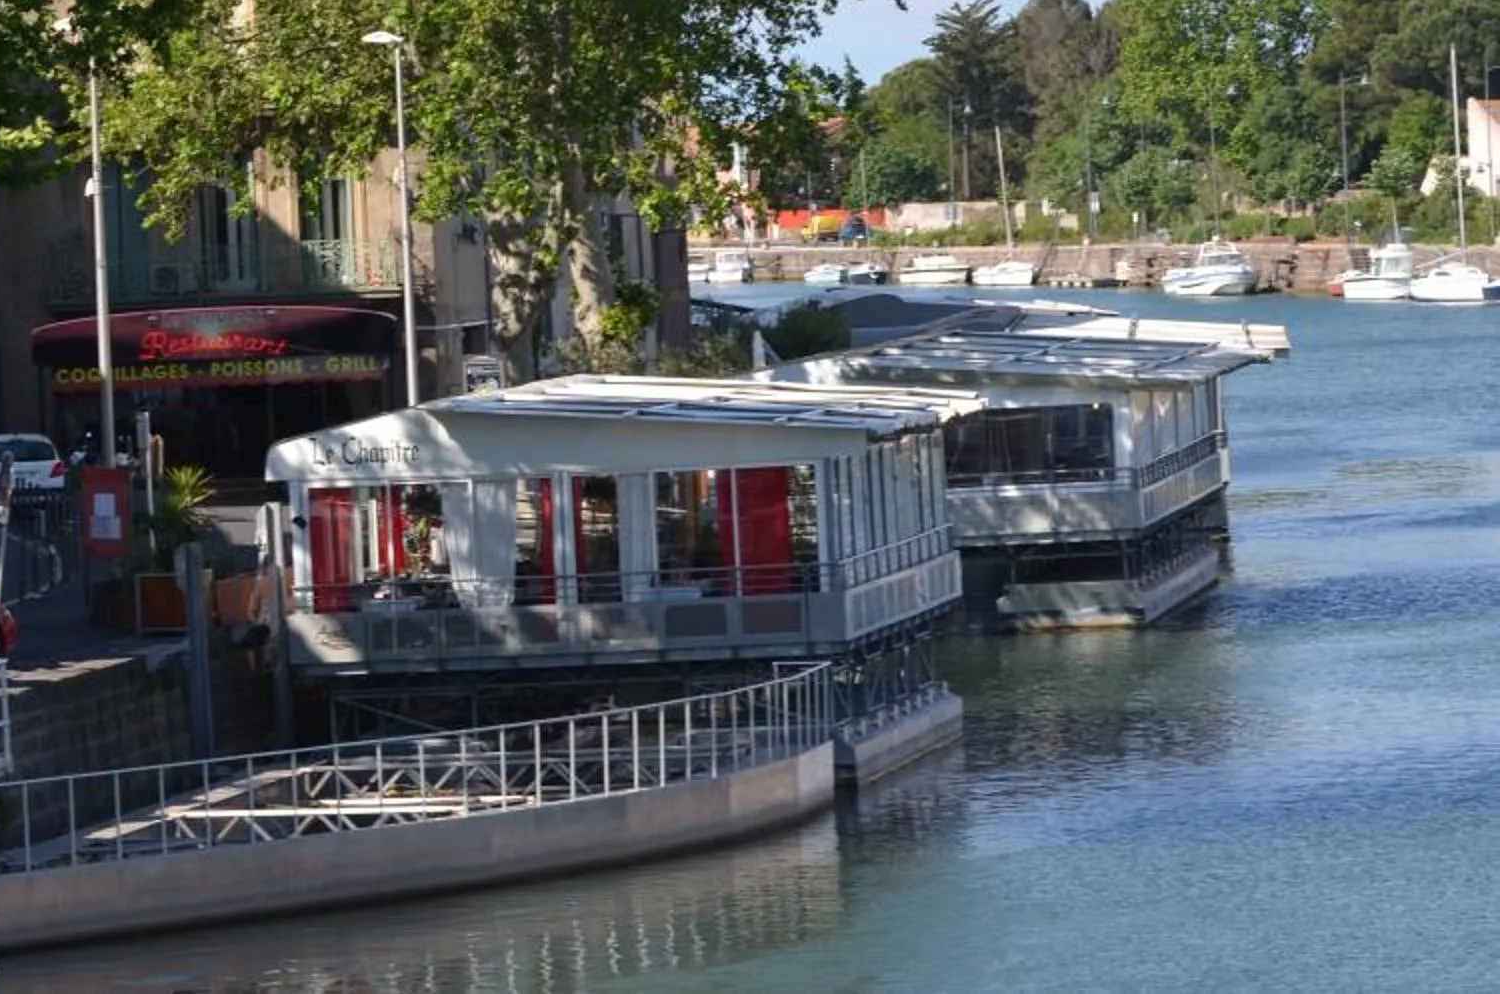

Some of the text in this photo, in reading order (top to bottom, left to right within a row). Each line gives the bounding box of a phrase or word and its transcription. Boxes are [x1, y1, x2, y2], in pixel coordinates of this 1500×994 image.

[56, 363, 190, 385] COQILLAGES
[210, 358, 304, 377] POISSONS
[324, 355, 378, 373] GRILL
[308, 435, 421, 470] Le Chapitre
